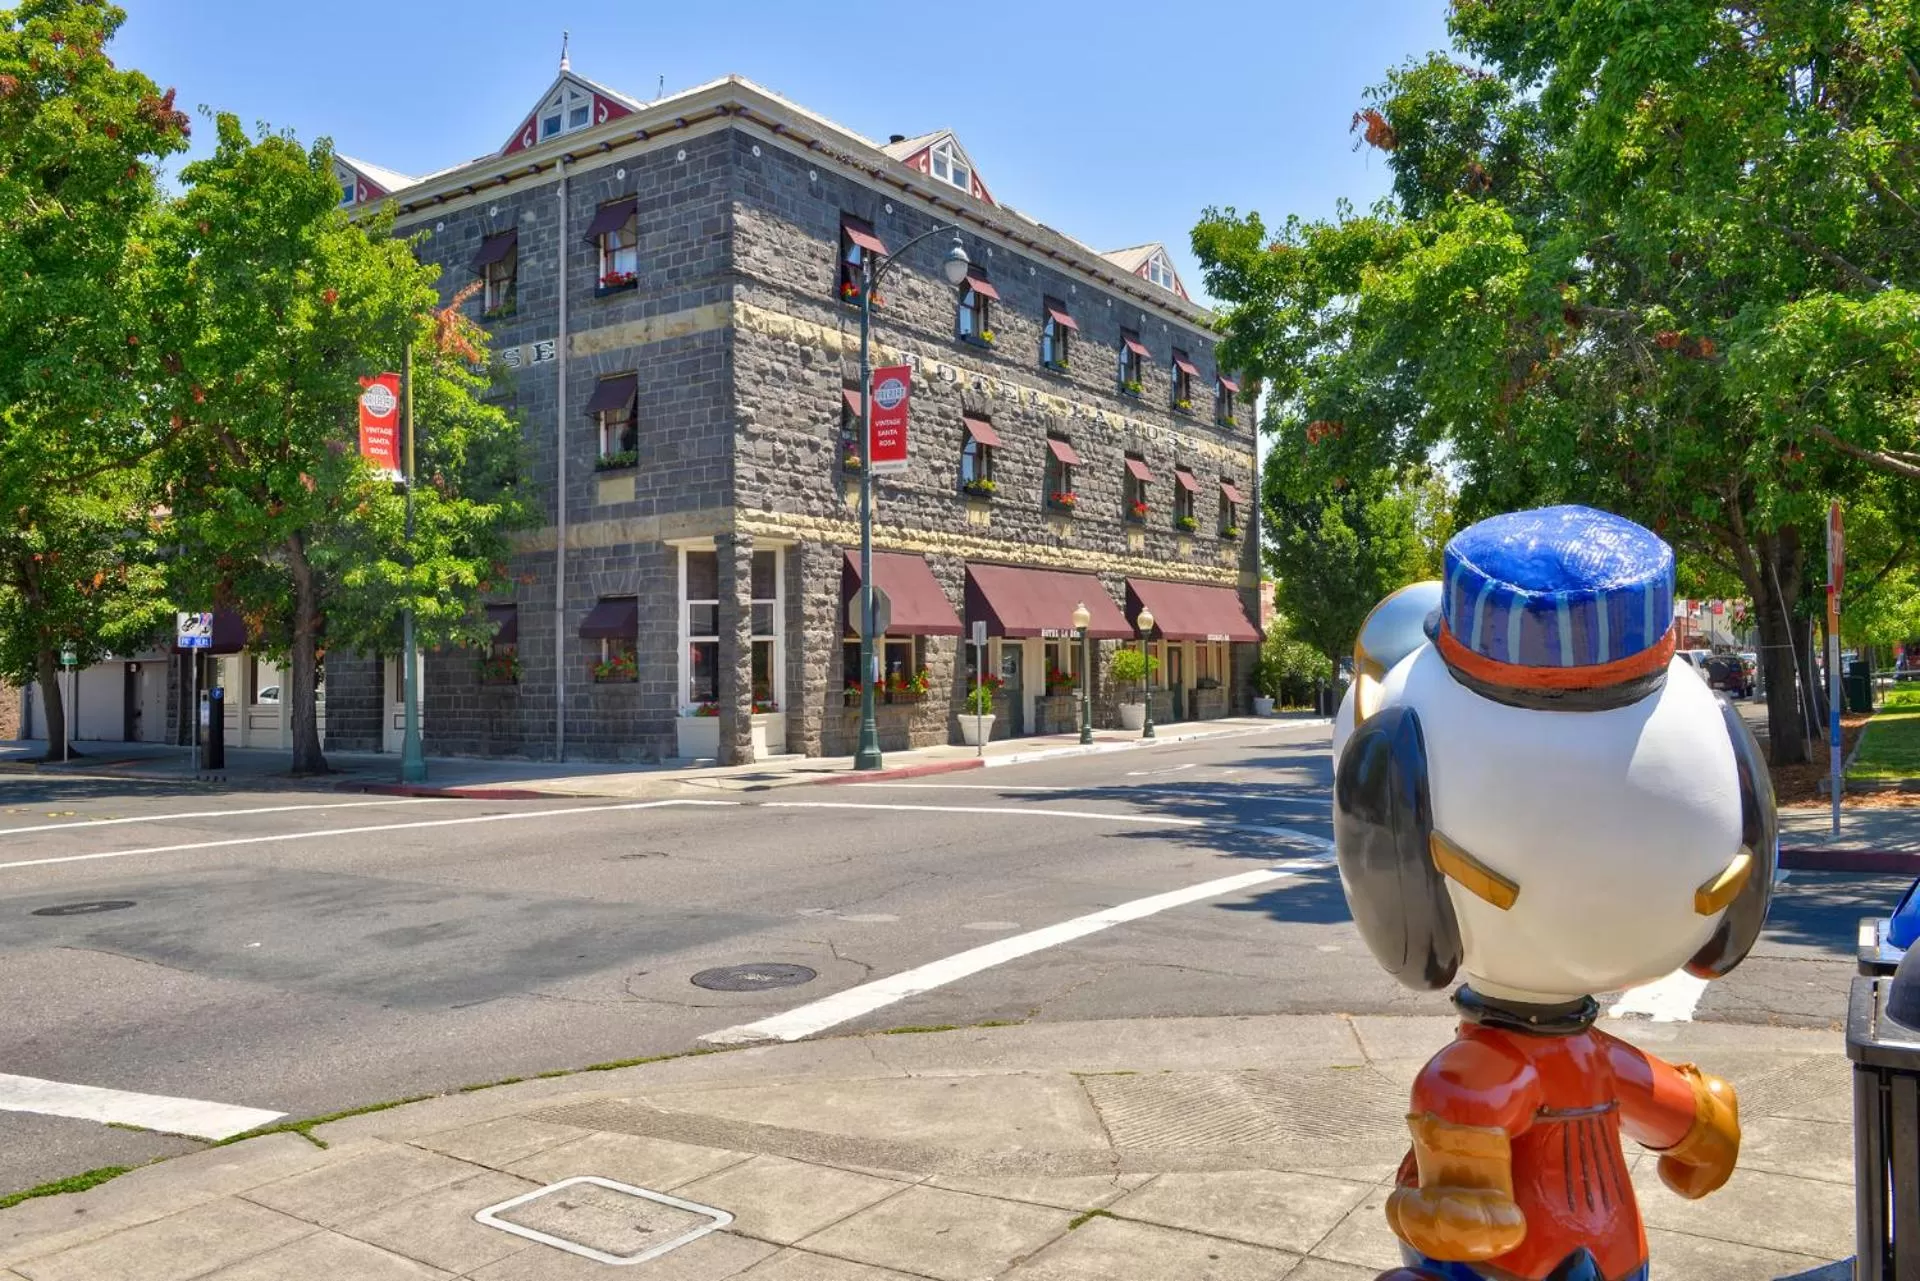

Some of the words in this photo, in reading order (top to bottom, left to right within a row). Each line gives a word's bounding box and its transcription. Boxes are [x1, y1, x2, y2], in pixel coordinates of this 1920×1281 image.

[900, 350, 1050, 409] HOTEL
[1072, 401, 1111, 426] LA
[1123, 418, 1201, 450] ROSE
[875, 418, 901, 427] VINTAGE
[365, 426, 393, 436] VINTAGE
[878, 429, 898, 437] SANTA
[368, 437, 390, 446] SANTA
[879, 439, 896, 447] ROSA
[370, 447, 388, 456] ROSA
